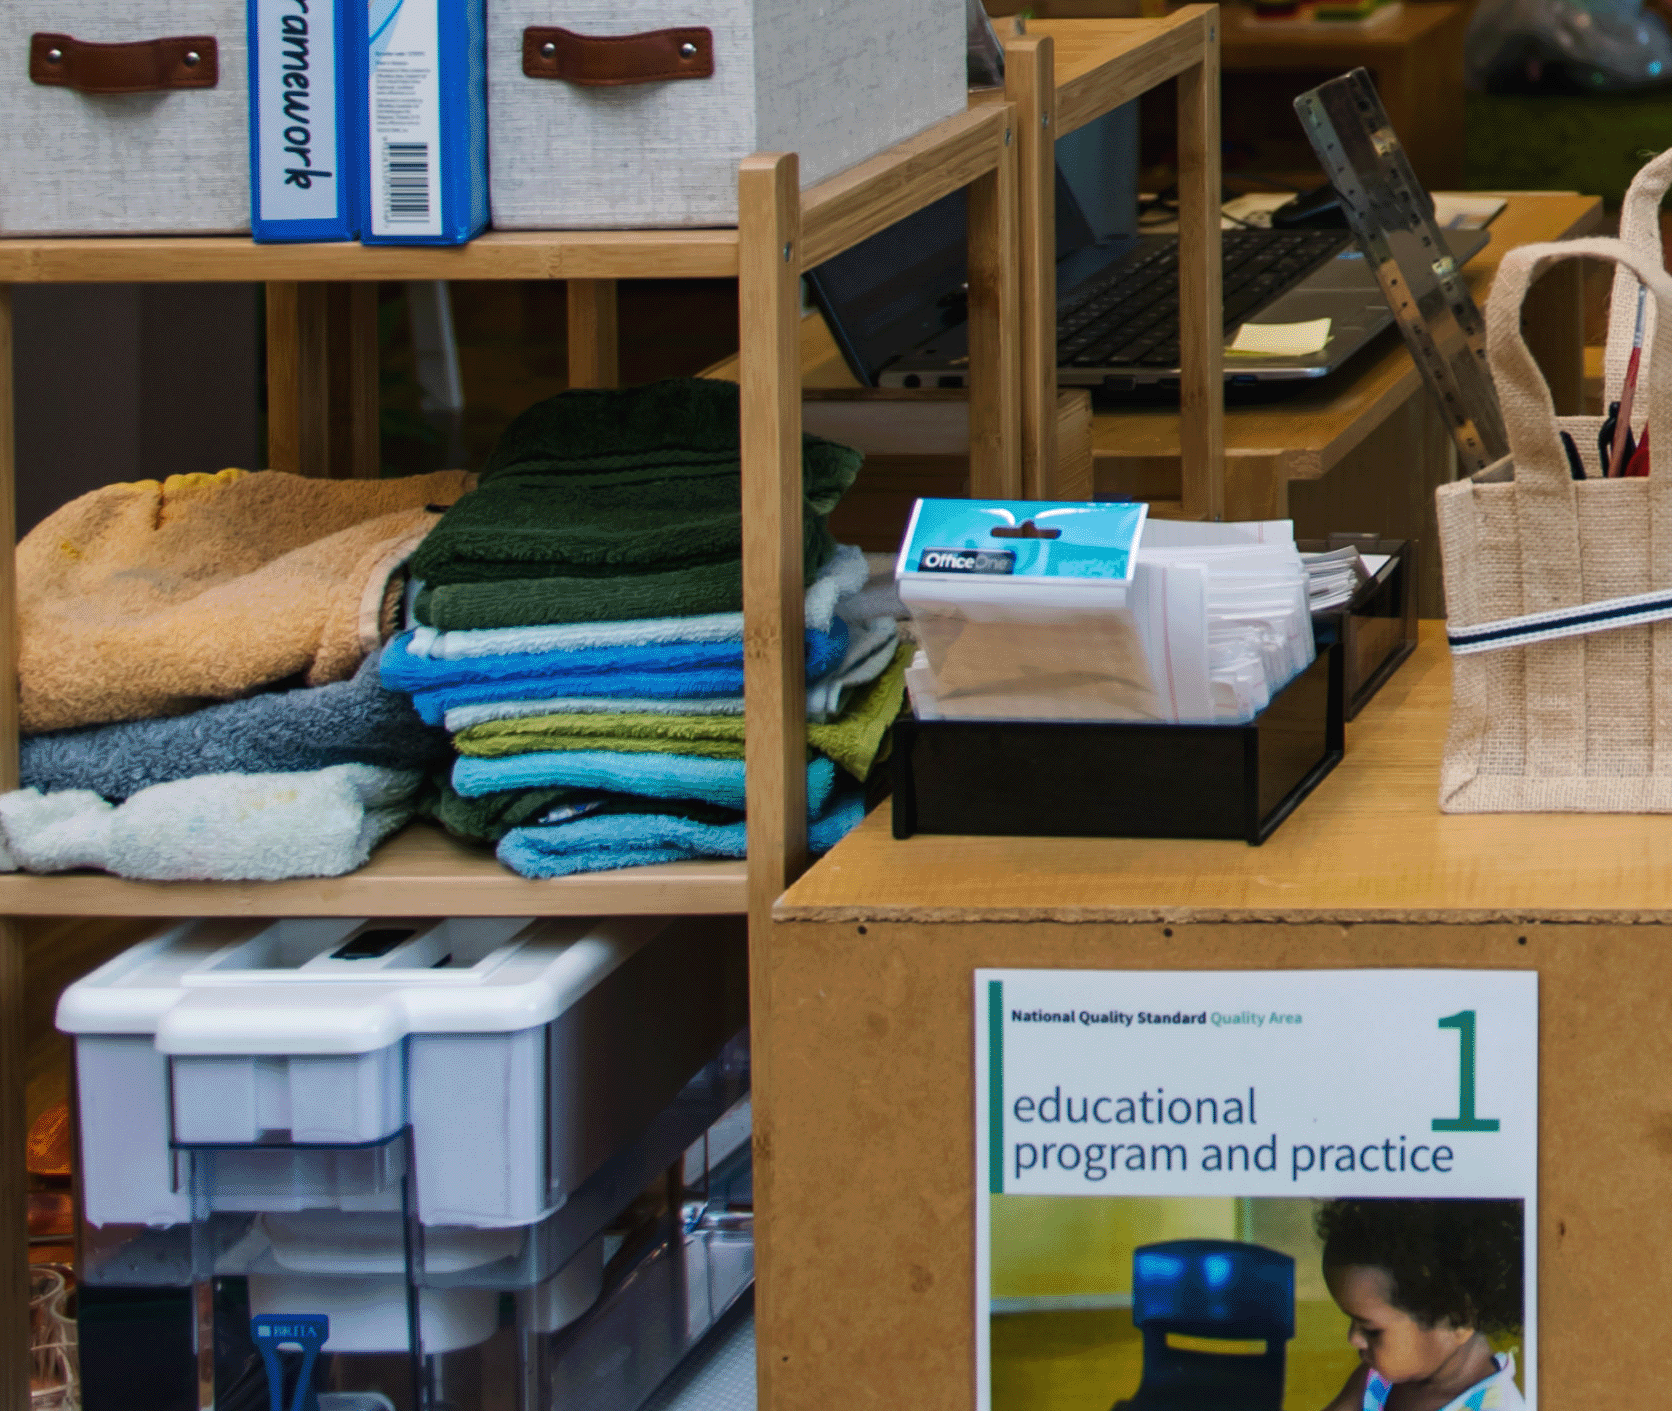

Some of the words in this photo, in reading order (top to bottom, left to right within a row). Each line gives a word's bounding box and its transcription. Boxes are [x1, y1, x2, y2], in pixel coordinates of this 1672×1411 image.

[923, 551, 1010, 572] OfficeOne
[1012, 1010, 1077, 1025] National
[1079, 1011, 1135, 1028] Quality
[1138, 1012, 1208, 1026] Standard
[1211, 1013, 1267, 1029] Quality
[1269, 1013, 1304, 1025] Area
[1432, 1010, 1502, 1134] 1
[1014, 1086, 1258, 1126] educational
[1015, 1143, 1188, 1183] program
[1202, 1134, 1278, 1173] and
[1293, 1136, 1455, 1183] practice
[274, 1325, 317, 1337] BRITA
